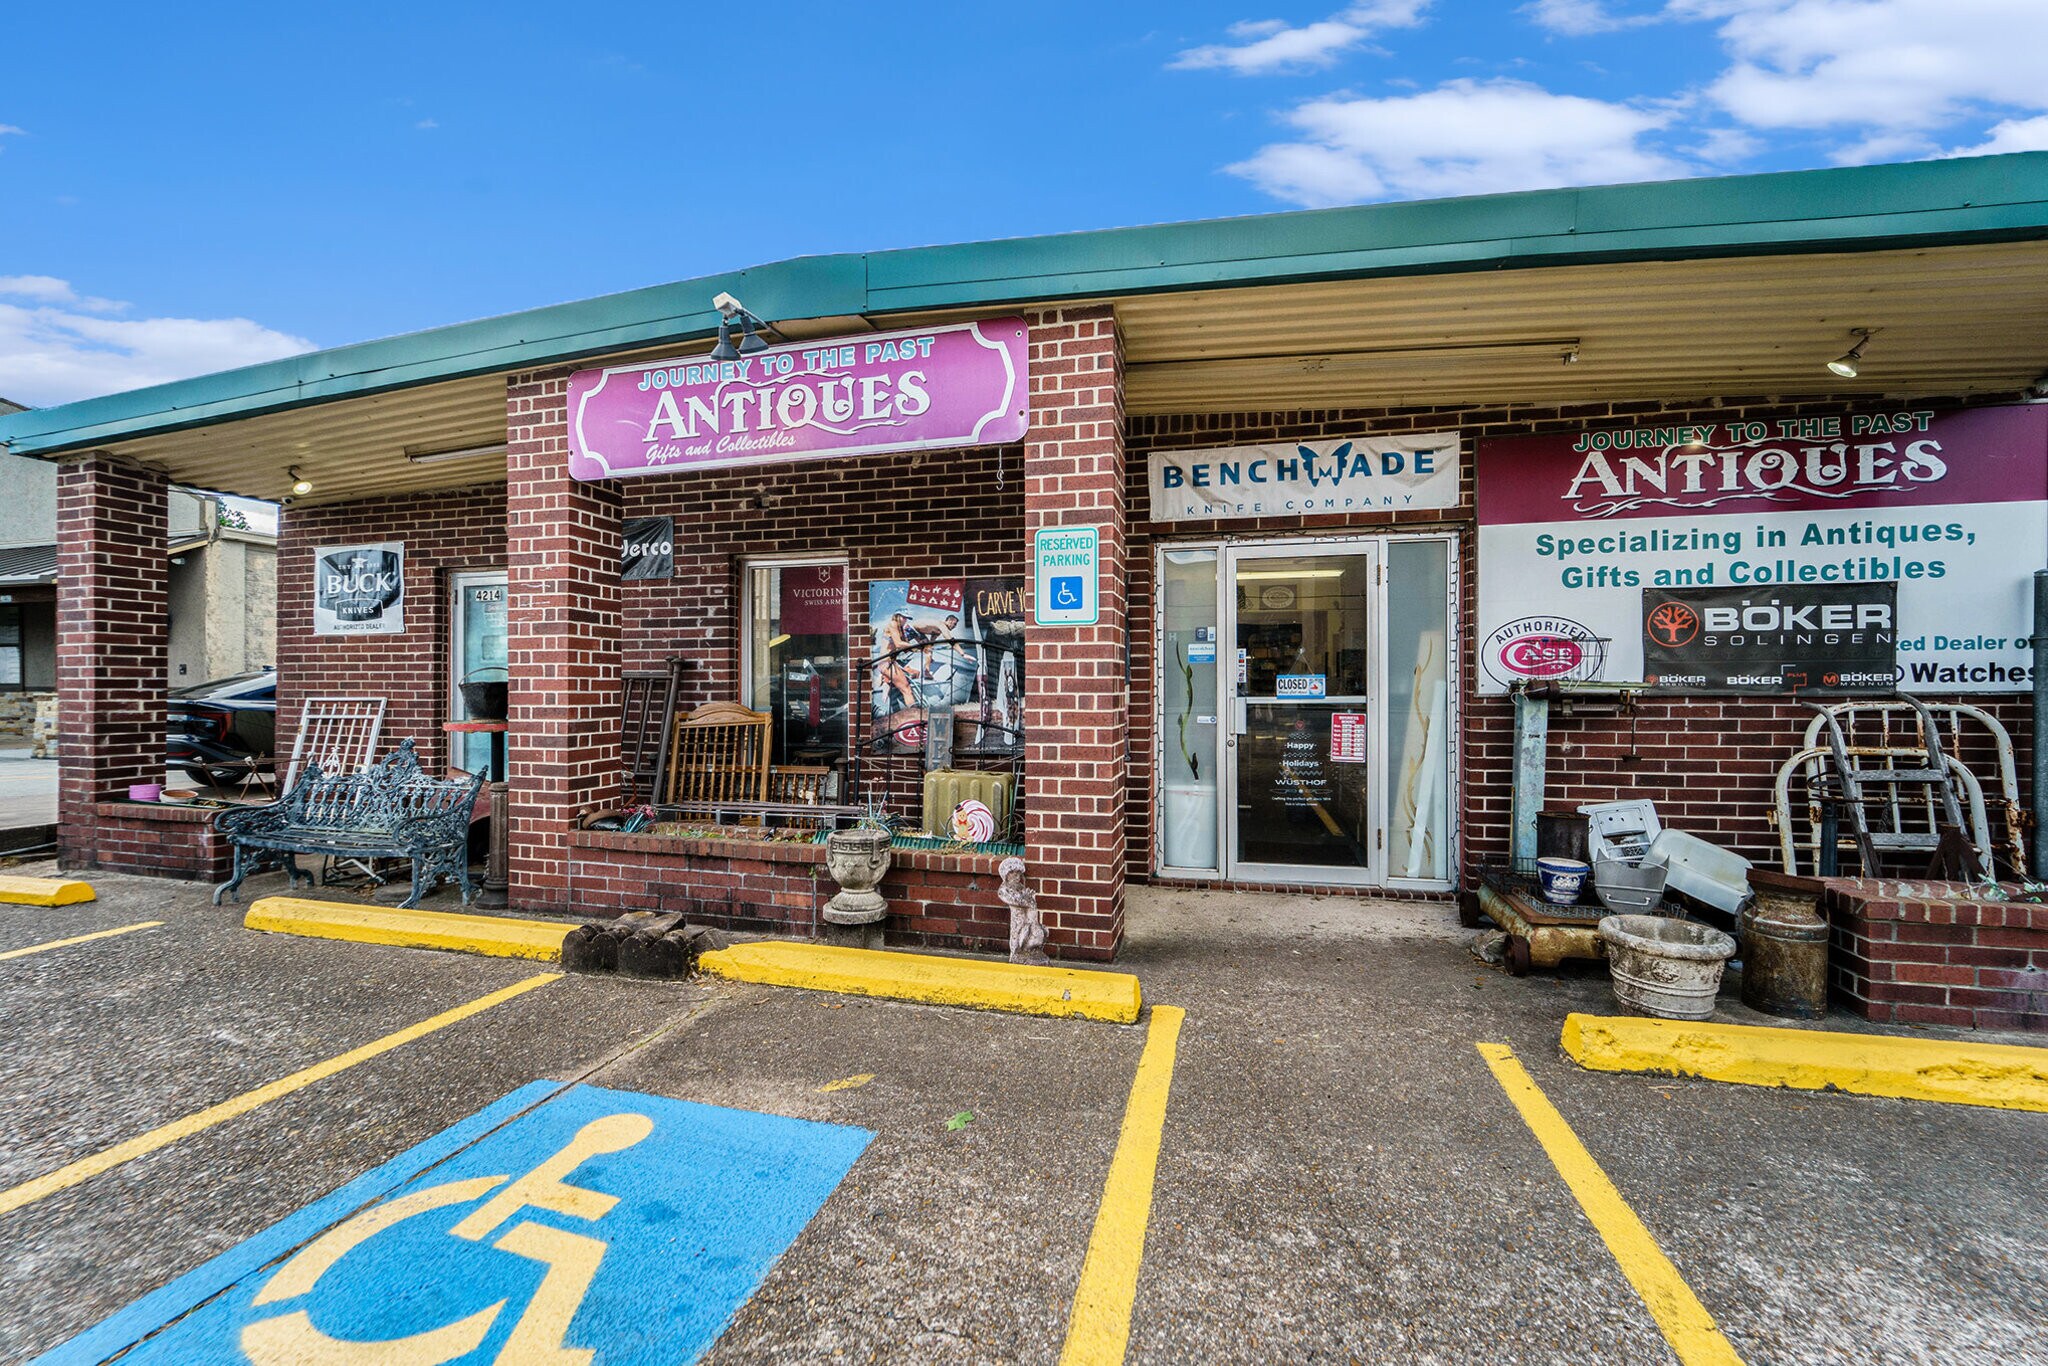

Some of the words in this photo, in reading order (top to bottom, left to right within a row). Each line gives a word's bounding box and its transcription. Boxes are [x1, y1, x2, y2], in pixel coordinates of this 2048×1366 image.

[638, 359, 752, 391] JOURNEY
[760, 354, 795, 377] TO
[802, 346, 856, 371] THE
[865, 337, 935, 364] PAST
[642, 371, 931, 443] ANTIQUES
[1573, 424, 1717, 452] JOURNEY
[1725, 421, 1768, 443] TO
[1777, 417, 1842, 438] THE
[1852, 410, 1935, 435] PAST
[645, 442, 681, 466] Gifts
[684, 440, 712, 457] and
[716, 431, 797, 454] Collectibles
[1163, 442, 1435, 489] BENCHMADE
[1561, 439, 1948, 499] ANTIQUES
[1187, 502, 1262, 515] KNIFE
[1286, 495, 1413, 509] COMPANY
[1040, 537, 1094, 550] RESERVED
[1535, 528, 1742, 560] Specializing
[1757, 525, 1786, 548] in
[1800, 521, 1976, 549] Antiques,
[1043, 553, 1090, 566] PARKING
[1561, 564, 1640, 589] Gifts
[1653, 562, 1714, 586] and
[1728, 556, 1946, 584] Collectibles
[327, 572, 393, 594] BUCK
[476, 590, 501, 601] 4214
[977, 590, 1016, 616] CARVE
[342, 607, 374, 615] KNIVES
[1704, 599, 1892, 632] BÖKER
[333, 623, 364, 631] AUHORIZD
[366, 622, 386, 630] DEALE
[1495, 620, 1587, 644] AUTHORIZED
[1704, 633, 1891, 647] SOLINGEN
[1896, 635, 1925, 651] ed
[1934, 635, 2007, 650] Dealer
[1506, 641, 1573, 668] CASE
[1277, 678, 1308, 690] CLOSED
[1660, 673, 1706, 683] BÖKER
[1727, 674, 1783, 685] BÖKER
[1840, 672, 1894, 682] BÖKER
[1286, 742, 1314, 750] Happy
[1282, 760, 1319, 768] Holidays
[1275, 778, 1327, 786] WÜSTHOF
